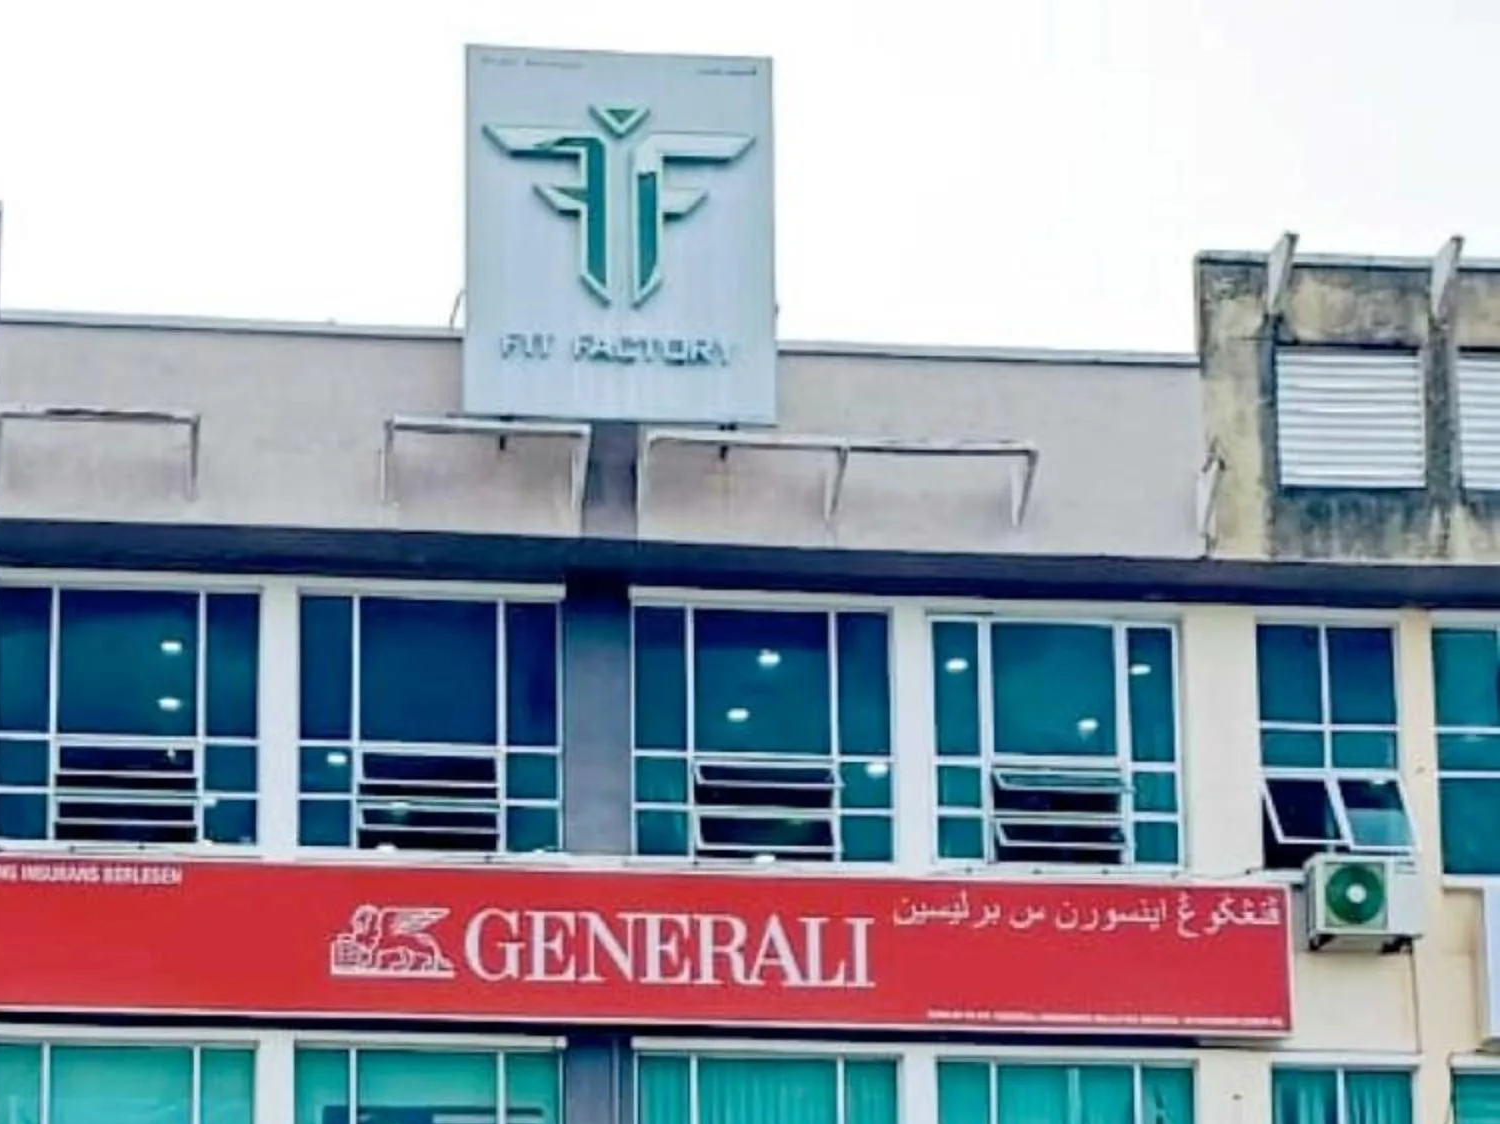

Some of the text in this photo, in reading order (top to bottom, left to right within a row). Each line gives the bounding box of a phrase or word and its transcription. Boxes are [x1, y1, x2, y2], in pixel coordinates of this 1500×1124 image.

[501, 333, 731, 367] FIT FACTORY
[21, 864, 100, 883] INSURANS
[464, 907, 875, 990] GENERALI
